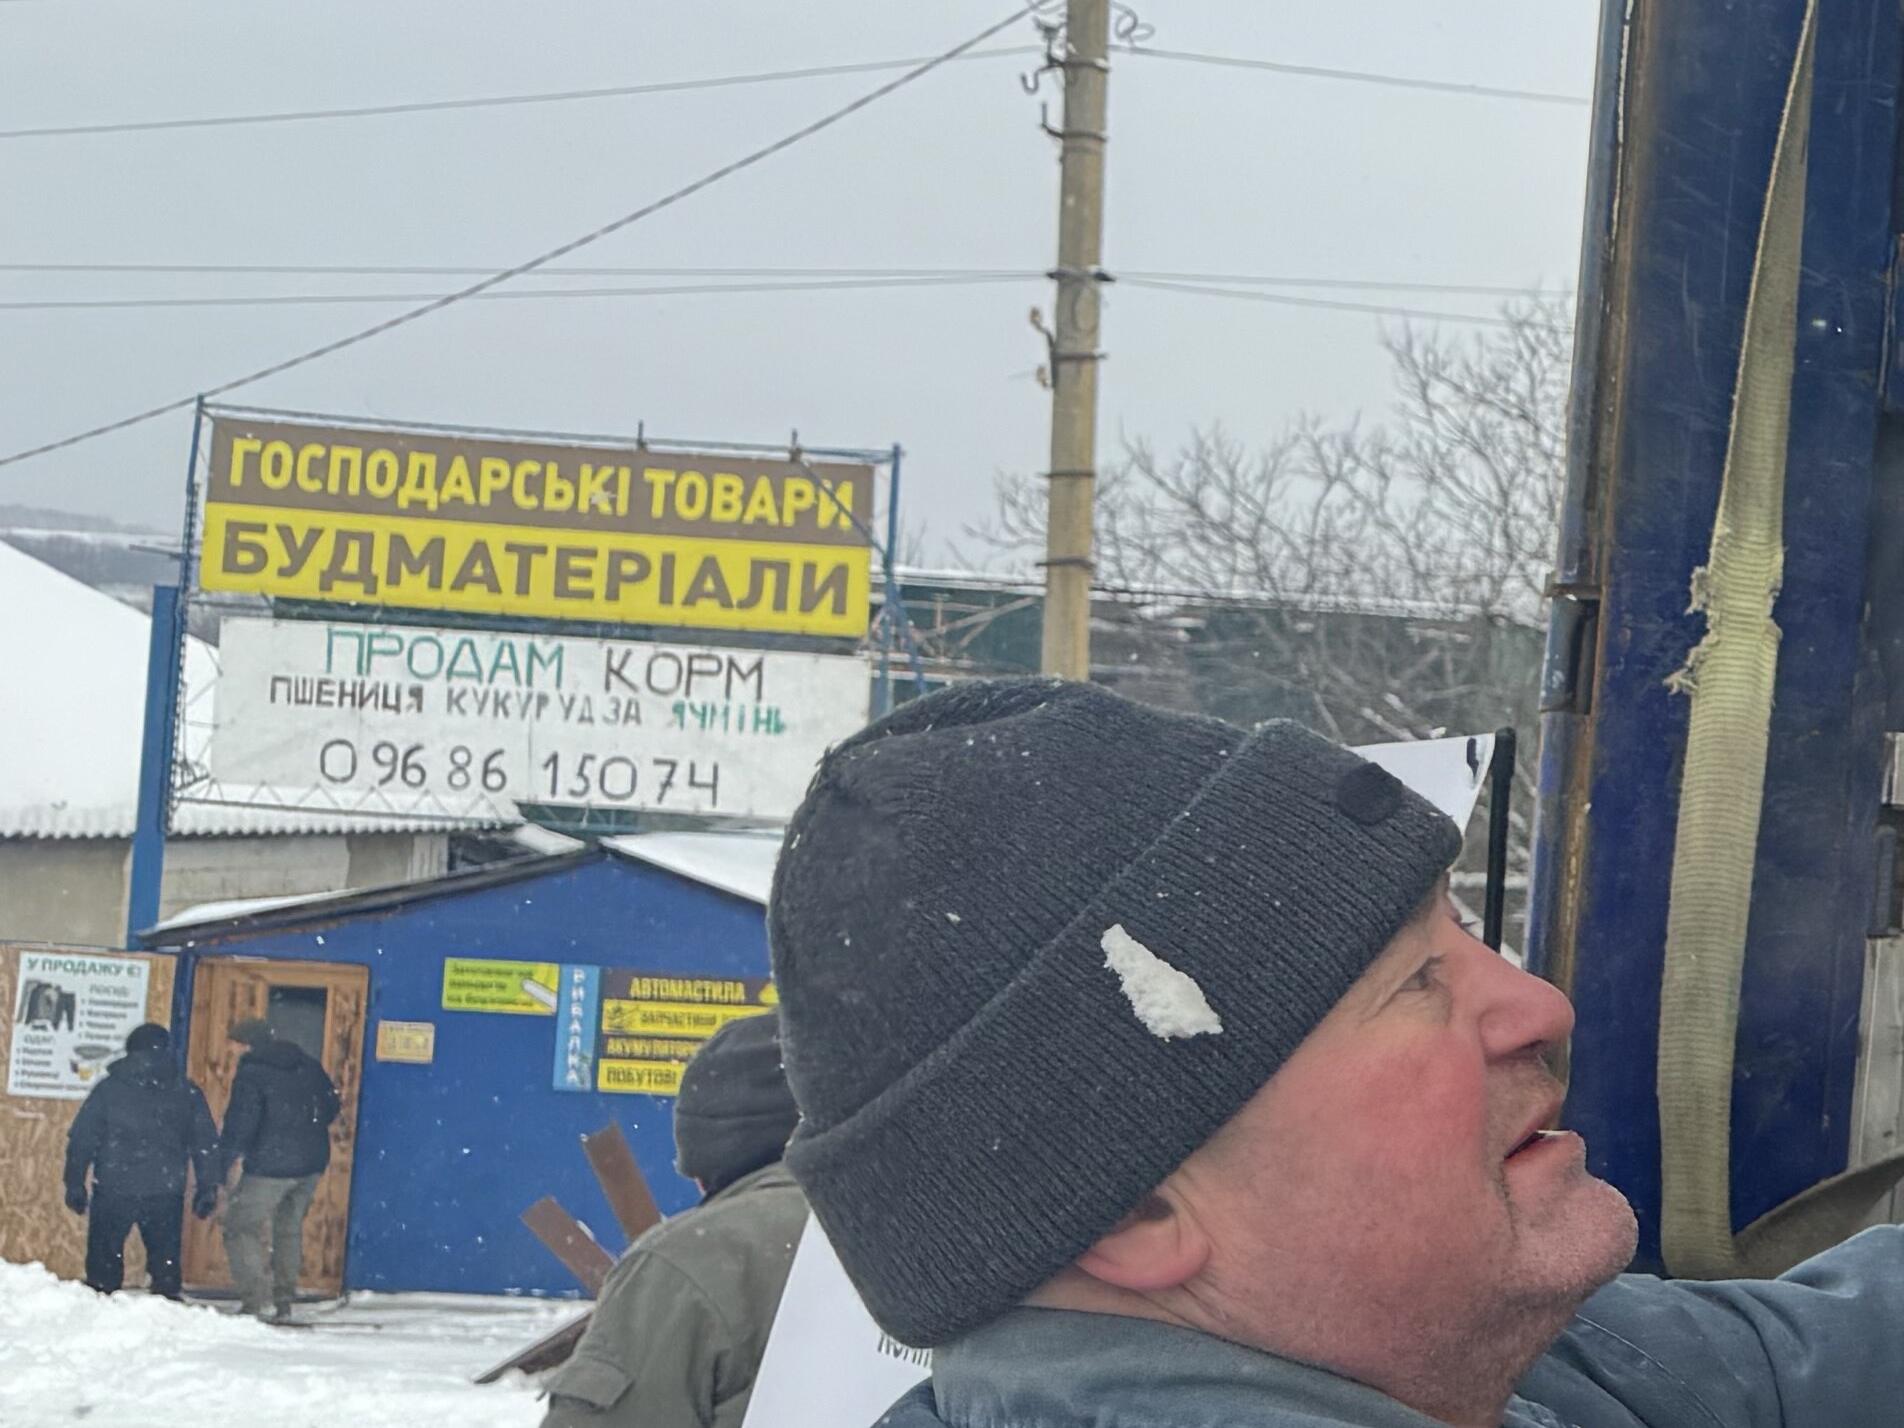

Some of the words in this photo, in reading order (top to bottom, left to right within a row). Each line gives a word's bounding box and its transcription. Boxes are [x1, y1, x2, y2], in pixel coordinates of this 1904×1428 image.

[229, 436, 629, 516] ГОСПОДАРСЬКІ
[645, 468, 854, 530] ТОВАРИ
[220, 520, 851, 615] БУДМАТЕРІАЛИ
[269, 675, 424, 714] ПШЕНИЦЯ
[672, 702, 787, 735] ЯЧМІНЬ
[326, 627, 564, 689] ПРОДАМ
[603, 647, 765, 701] КОРМ
